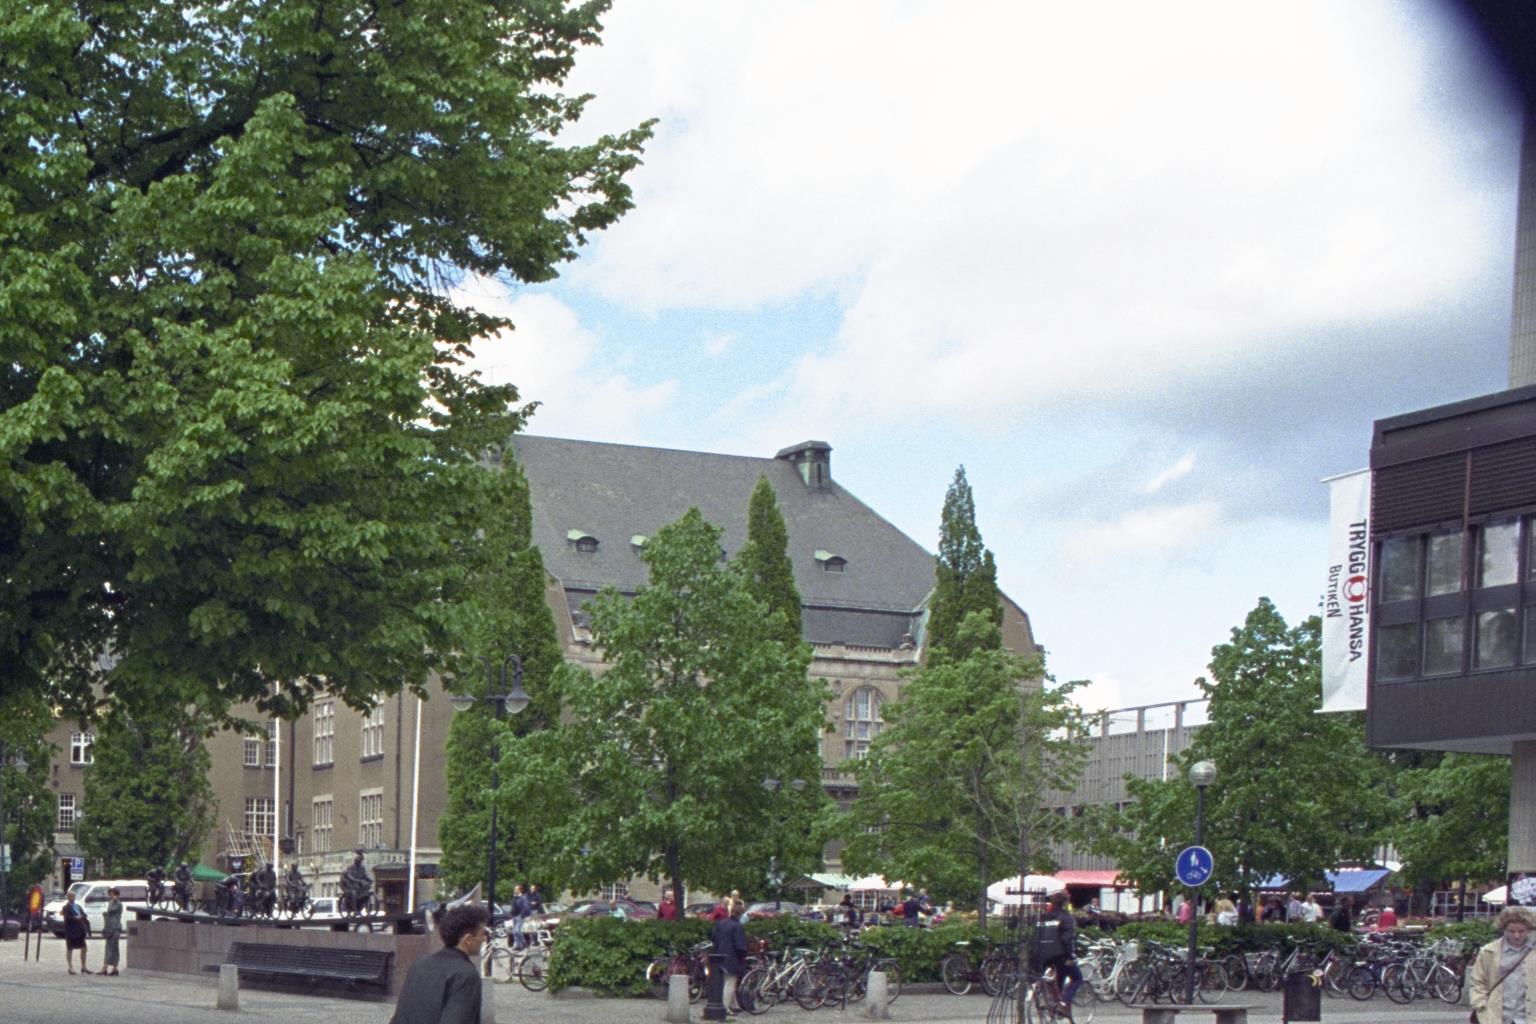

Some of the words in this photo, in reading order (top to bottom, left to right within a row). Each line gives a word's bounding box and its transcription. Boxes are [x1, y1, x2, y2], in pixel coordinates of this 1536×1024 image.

[1349, 518, 1367, 574] TRYGG
[1326, 564, 1343, 618] BUTIKEN
[1349, 604, 1364, 662] HANSA
